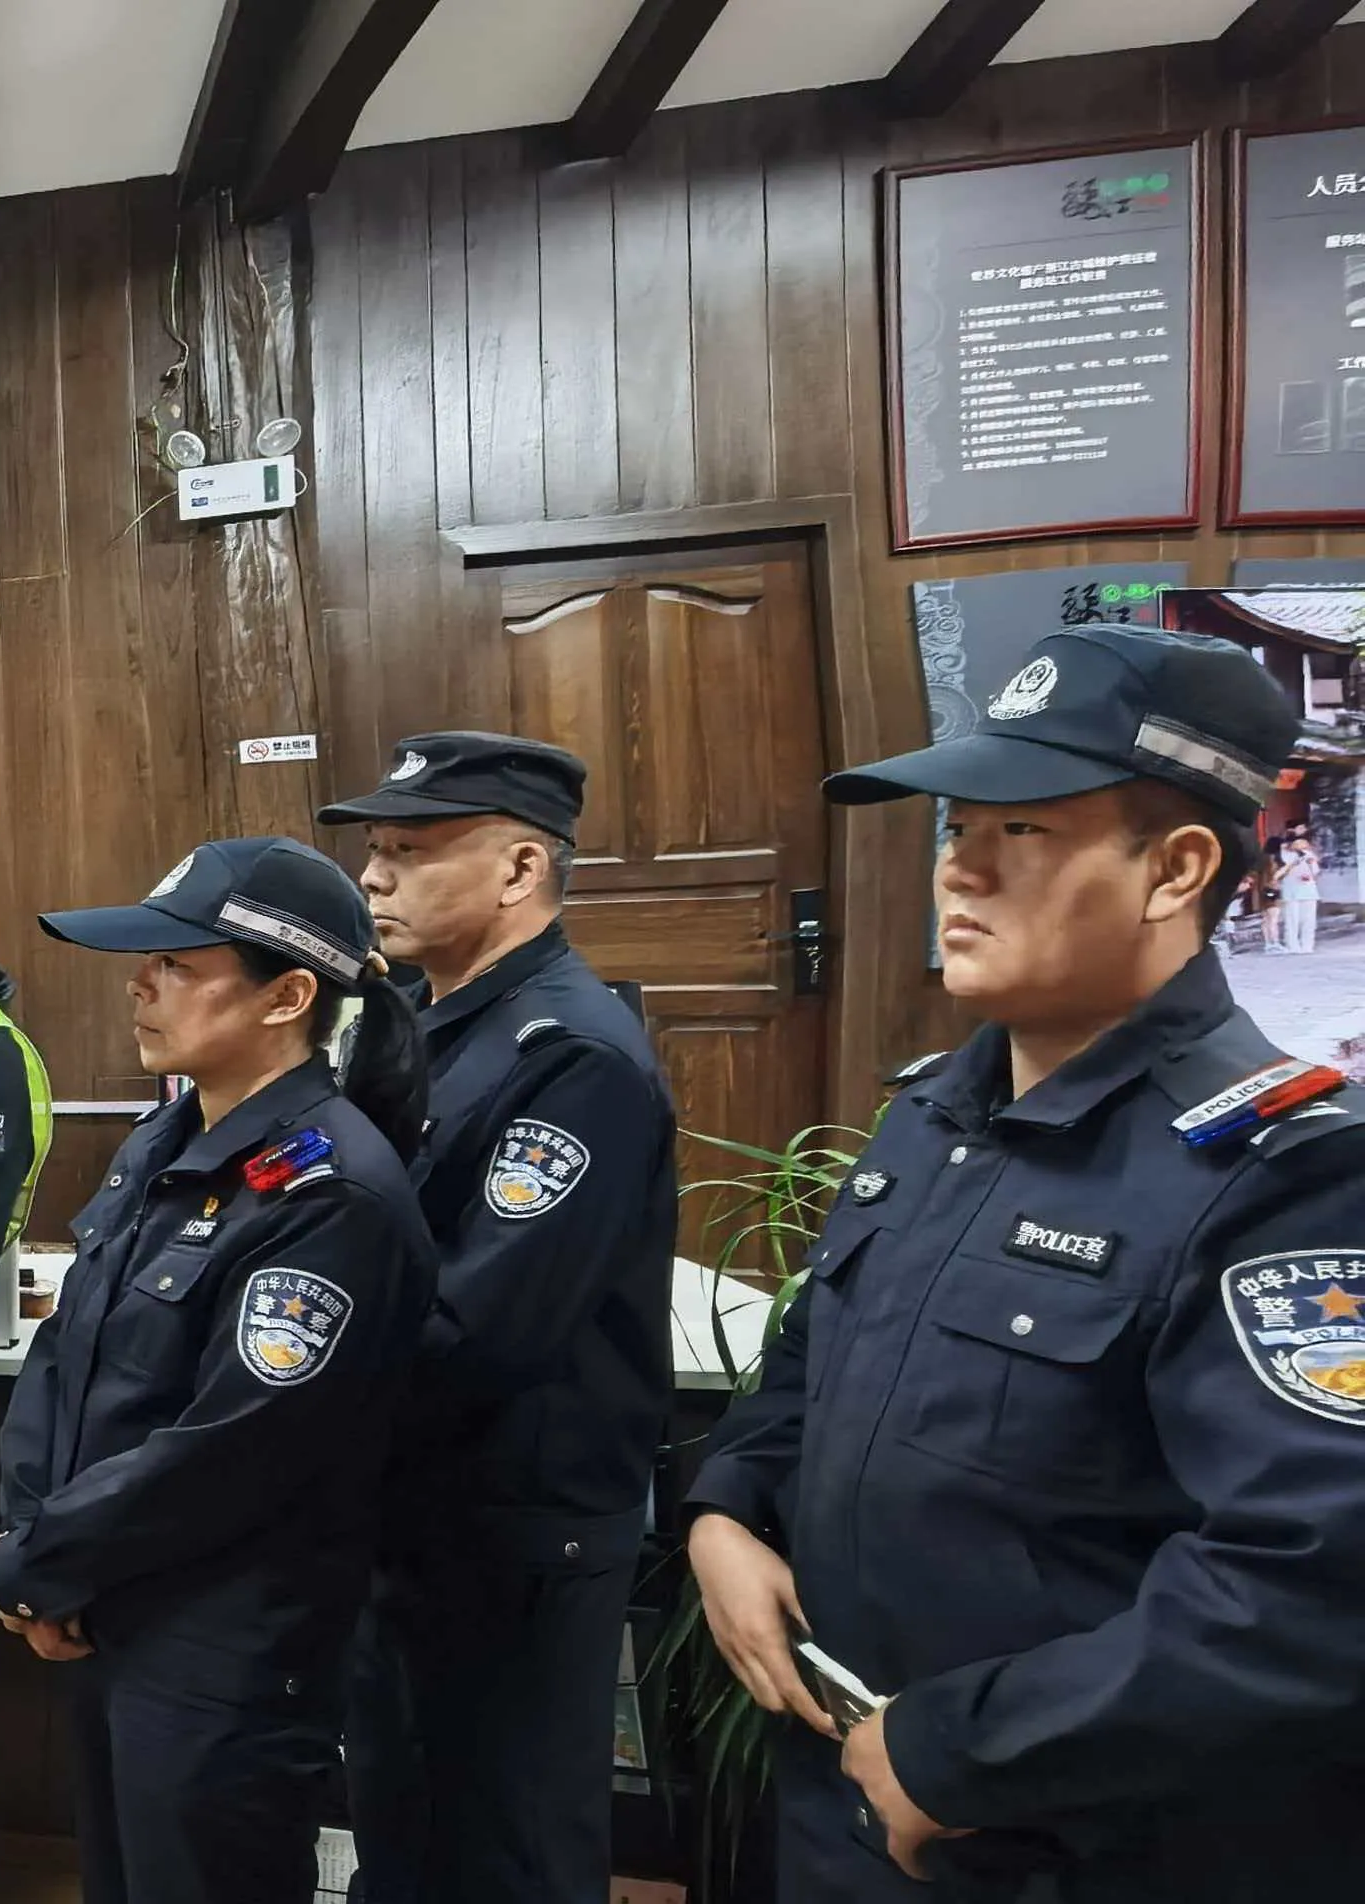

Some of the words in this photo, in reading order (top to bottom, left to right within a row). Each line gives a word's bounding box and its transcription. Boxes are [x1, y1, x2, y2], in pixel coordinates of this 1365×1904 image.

[1203, 1079, 1266, 1116] POLICE
[256, 1276, 345, 1318] 中华人民共和国
